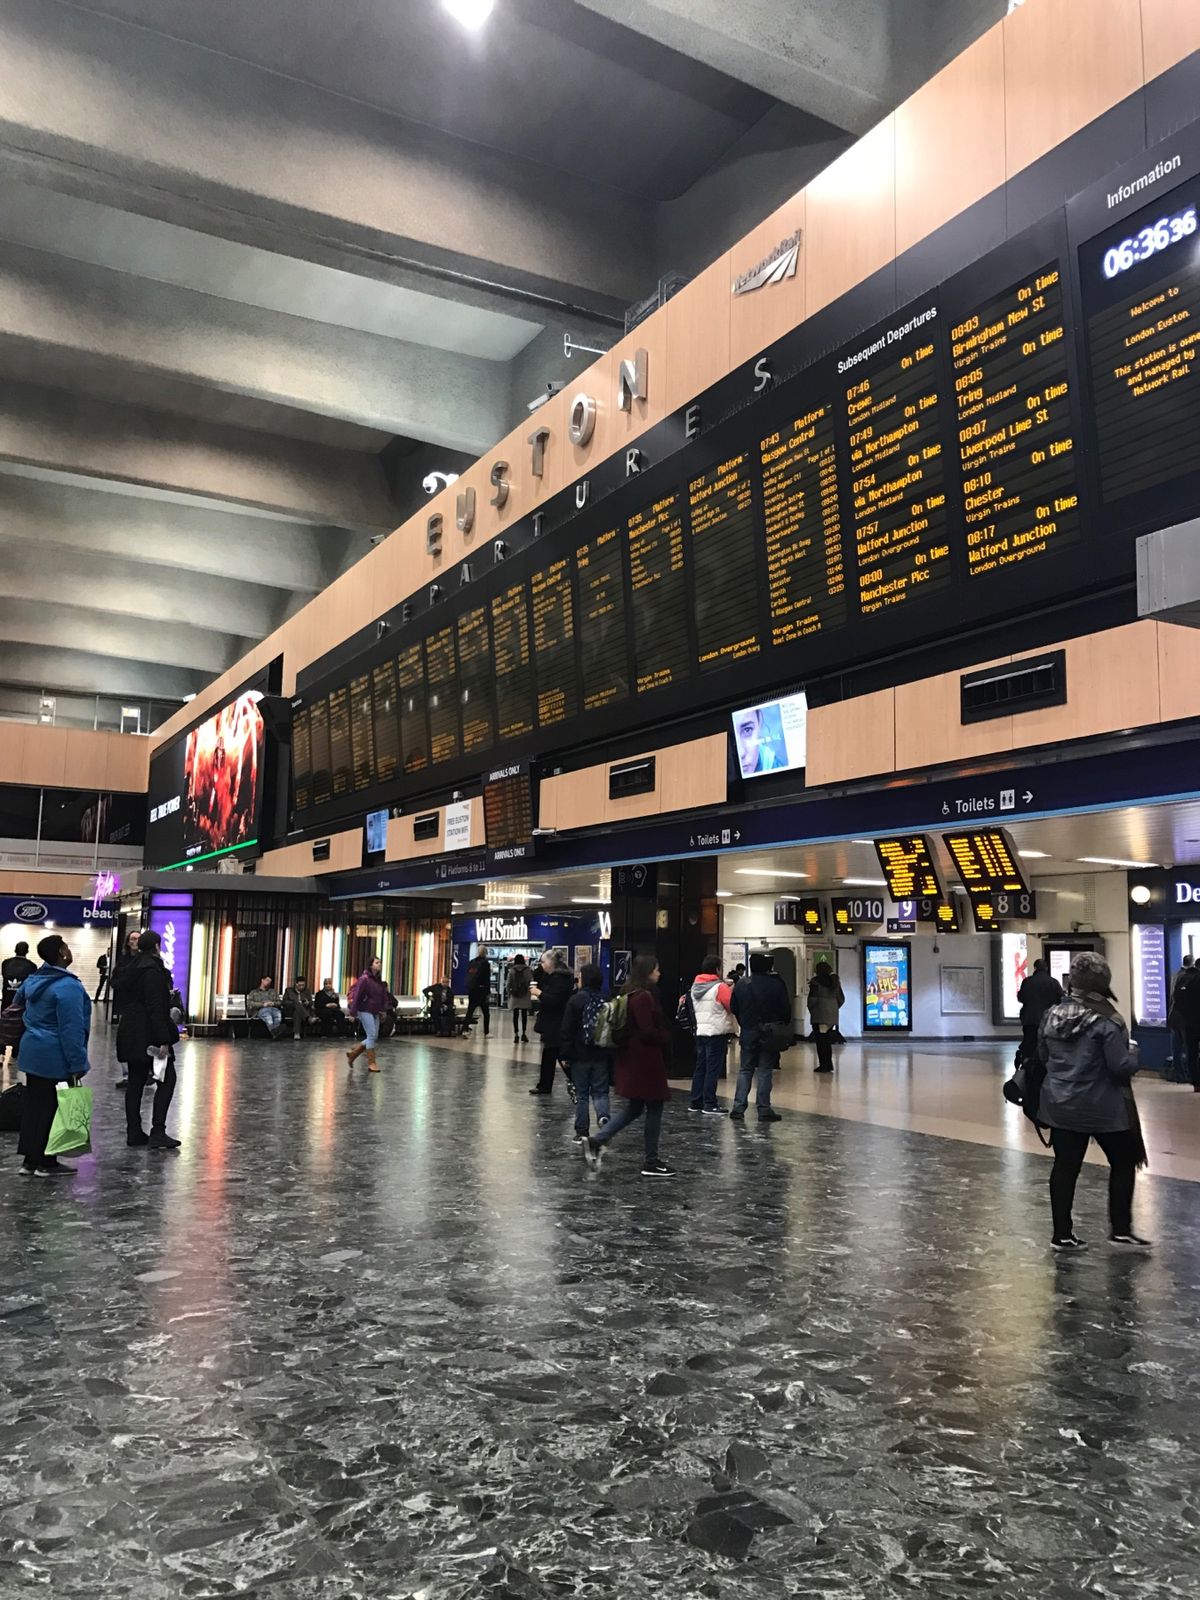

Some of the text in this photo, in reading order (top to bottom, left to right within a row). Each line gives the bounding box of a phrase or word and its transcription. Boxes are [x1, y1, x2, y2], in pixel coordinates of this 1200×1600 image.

[1107, 155, 1181, 208] Information
[1018, 271, 1059, 302] On time
[1131, 287, 1179, 317] Welcome to
[951, 316, 978, 340] 08:03
[952, 296, 1046, 357] Birmingham New St
[1125, 310, 1190, 346] London Euston.
[837, 307, 937, 374] Subsequent Departures
[954, 336, 1007, 369] Virgin Trains
[1022, 326, 1063, 356] On time
[901, 343, 934, 368] On time
[1114, 365, 1131, 378] This
[1134, 349, 1166, 370] station
[1169, 344, 1176, 352] is
[1127, 349, 1195, 386] and managed by
[847, 379, 870, 400] 07:46
[955, 369, 983, 392] 08:05
[1134, 374, 1169, 396] Network
[848, 395, 872, 415] Crewe
[904, 393, 938, 417] On time
[957, 388, 983, 409] Tring
[958, 385, 1017, 421] London Midland
[1027, 382, 1068, 410] On time
[760, 406, 824, 450] 07:43 Platform
[788, 427, 815, 448] Central
[850, 426, 873, 446] 07:49
[960, 420, 987, 443] 08:07
[960, 409, 1049, 460] Liverpool Lime St
[426, 348, 648, 556] EUSTON
[851, 420, 918, 462] via Northampton
[1032, 438, 1073, 464] On time
[908, 443, 941, 466] On time
[962, 441, 1016, 471] Virgin Trains
[853, 474, 876, 493] 07:54
[854, 469, 922, 508] via Northampton
[964, 472, 991, 494] 08:10
[376, 357, 773, 640] DEPARTURES
[912, 495, 945, 516] On time
[965, 486, 1004, 511] Chester
[966, 495, 1020, 523] Virgin Trains
[1036, 494, 1078, 519] On time
[856, 521, 879, 539] 07:57
[857, 519, 928, 555] Watford Junction
[968, 525, 996, 546] 08:17
[968, 522, 1056, 563] Watford Junction
[858, 553, 880, 566] London
[916, 545, 949, 565] On time
[970, 542, 1046, 576] London Overground
[859, 569, 883, 587] 08:00
[860, 570, 929, 602] Manchester Picc
[862, 592, 906, 613] Virgin Trains
[956, 798, 995, 813] Toilets
[697, 833, 719, 846] Toilets
[776, 904, 787, 920] 11
[847, 900, 882, 918] 10 10
[902, 900, 932, 917] 9 9
[998, 894, 1030, 913] 8 8
[475, 916, 528, 941] WHSmith
